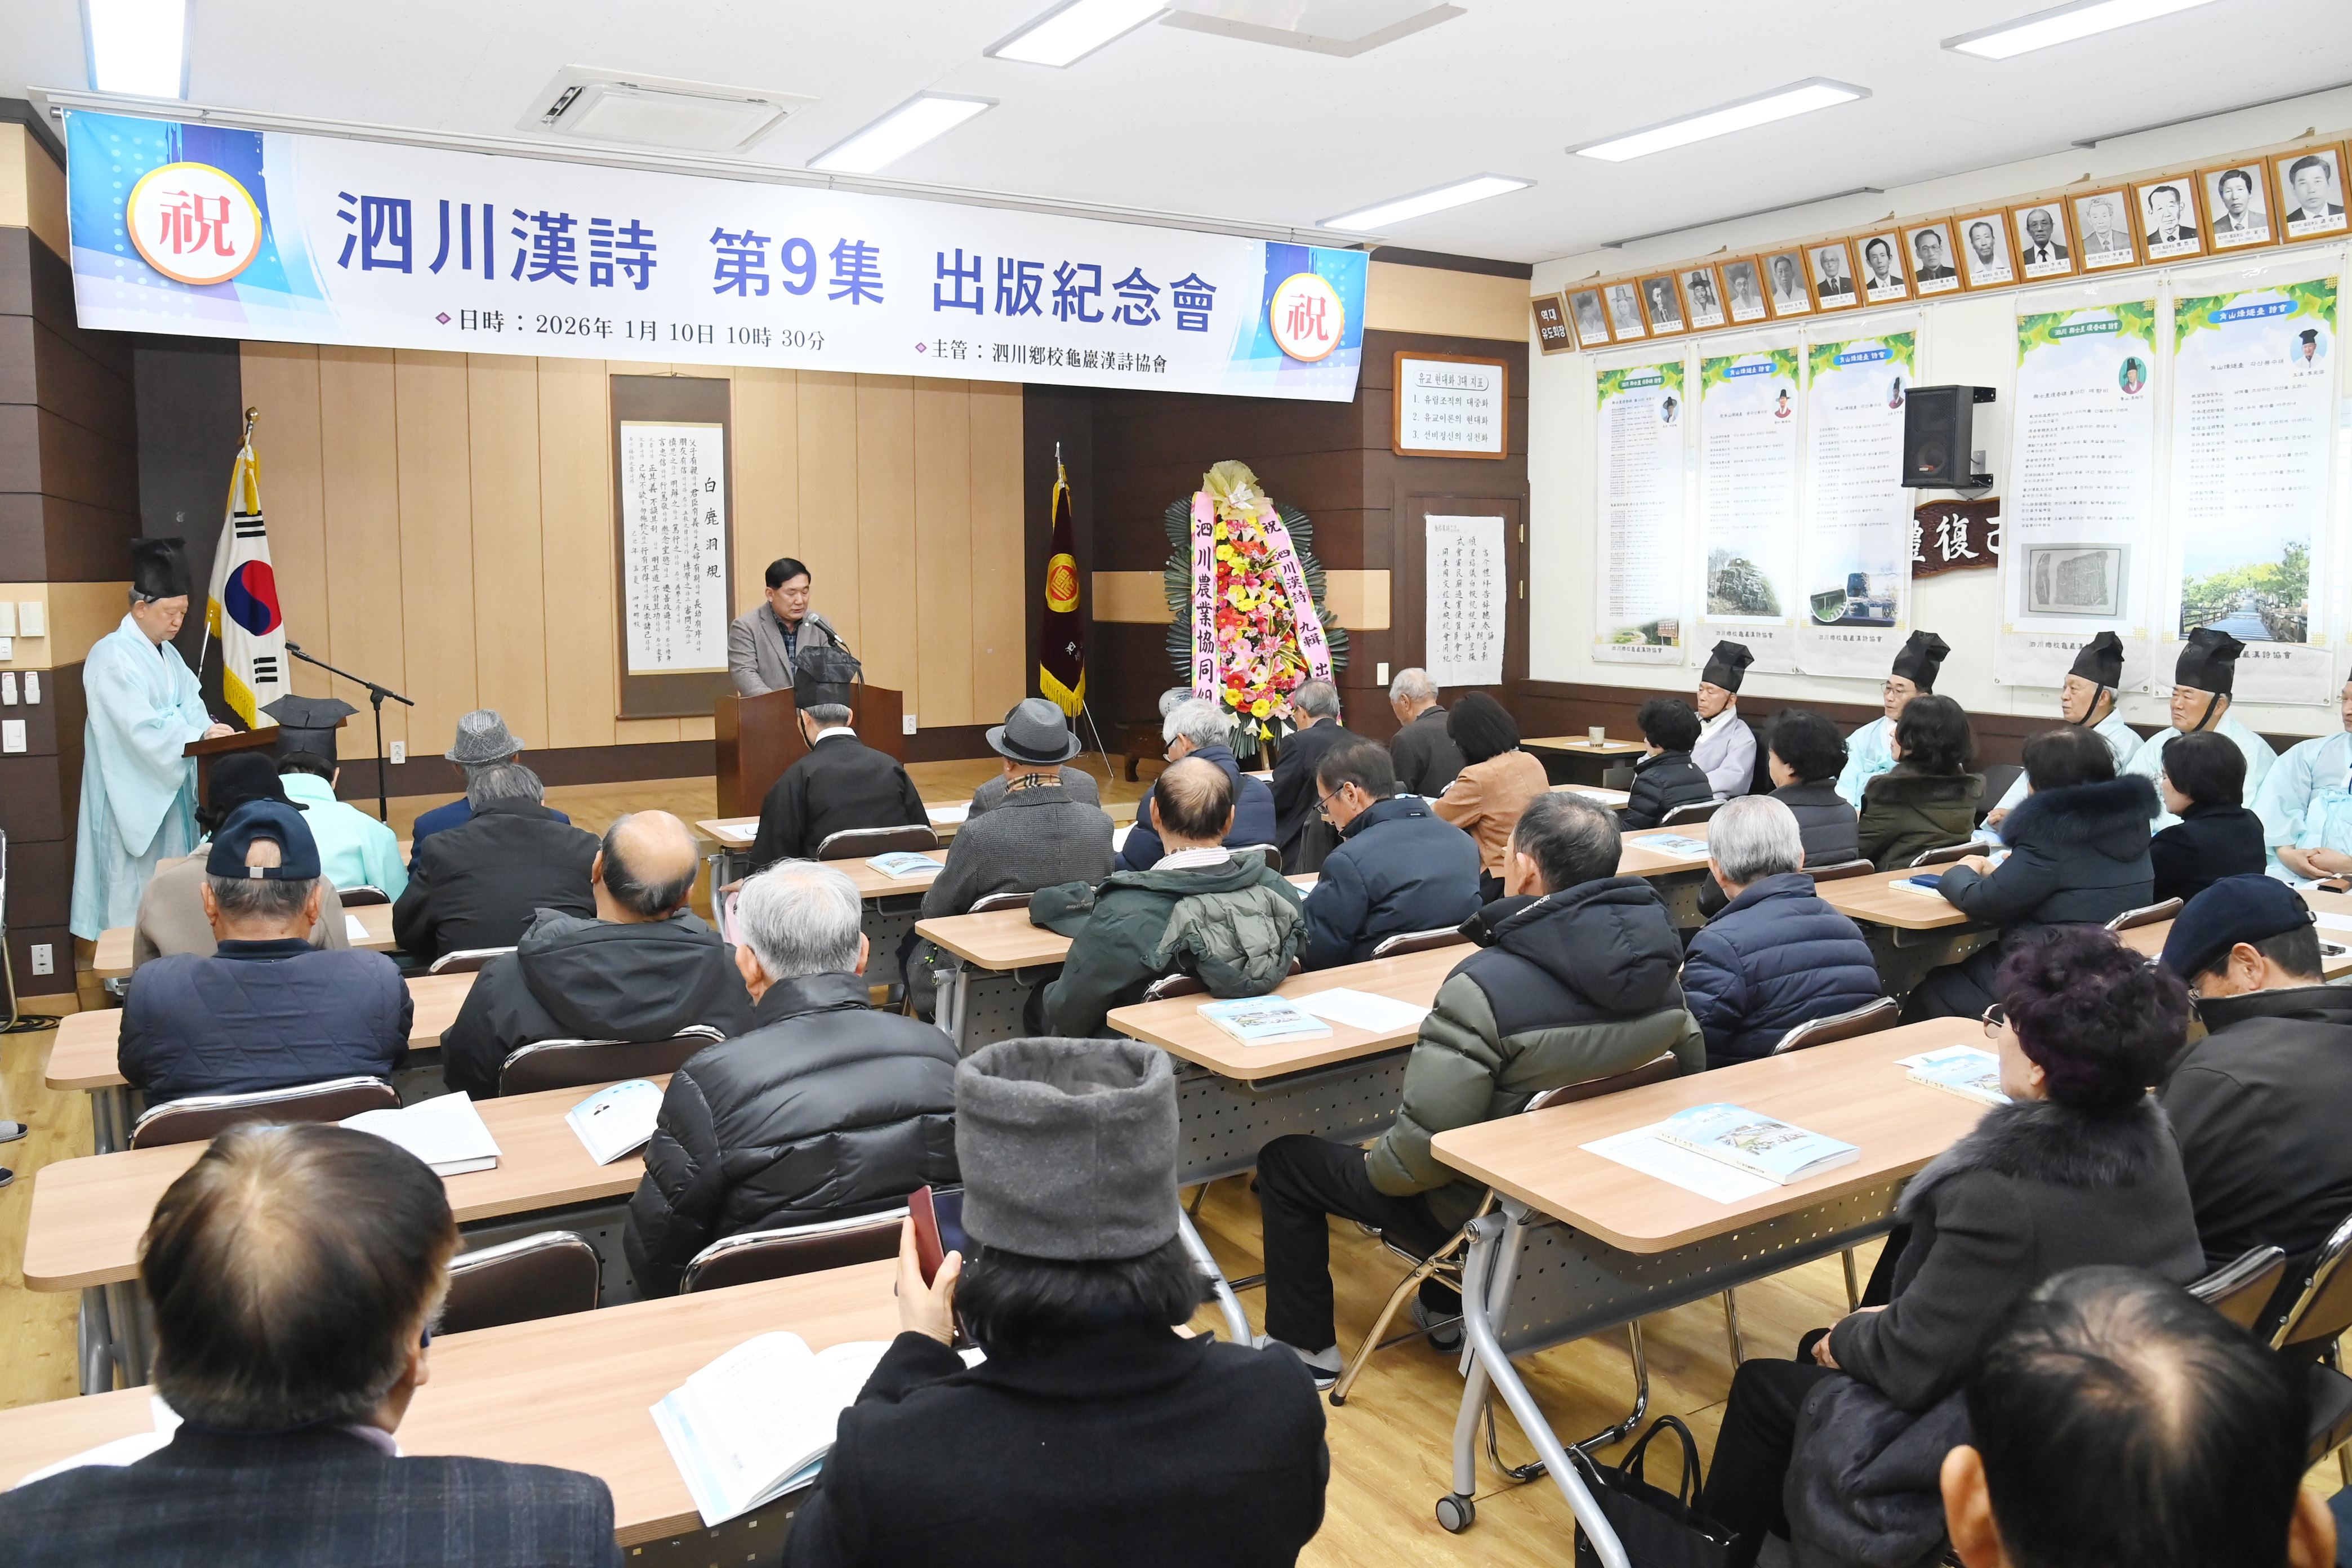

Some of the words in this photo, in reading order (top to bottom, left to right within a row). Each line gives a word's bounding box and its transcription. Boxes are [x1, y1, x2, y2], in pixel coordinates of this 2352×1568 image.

[161, 190, 236, 257] 祝
[336, 191, 657, 291] 泗川漢詩
[709, 226, 884, 305] 第9集
[933, 248, 1218, 333] 出版紀念會
[1286, 293, 1328, 341] 祝
[1540, 308, 1557, 322] 역대
[460, 309, 505, 333] 日時
[536, 314, 613, 339] 2026年
[625, 320, 657, 342] 1月
[669, 323, 714, 345] 10日
[727, 326, 772, 348] 10時
[782, 328, 825, 351] 30分
[1542, 325, 1566, 340] 유도회장
[931, 338, 968, 360] 主管
[1419, 372, 1432, 384] 유교
[1435, 373, 1455, 386] 현대화
[1458, 375, 1467, 387] 3대
[1471, 376, 1484, 388] 지표
[1424, 395, 1462, 407] 유림조직의
[1467, 398, 1489, 408] 대중화
[1424, 413, 1462, 424] 유교이론의
[1467, 415, 1488, 425] 현대화
[1424, 430, 1461, 442] 선비정신의
[1466, 432, 1488, 443] 실천화
[704, 476, 721, 578] 白鹿洞規
[1263, 521, 1282, 535] 祝
[1533, 894, 1551, 907] SPORT
